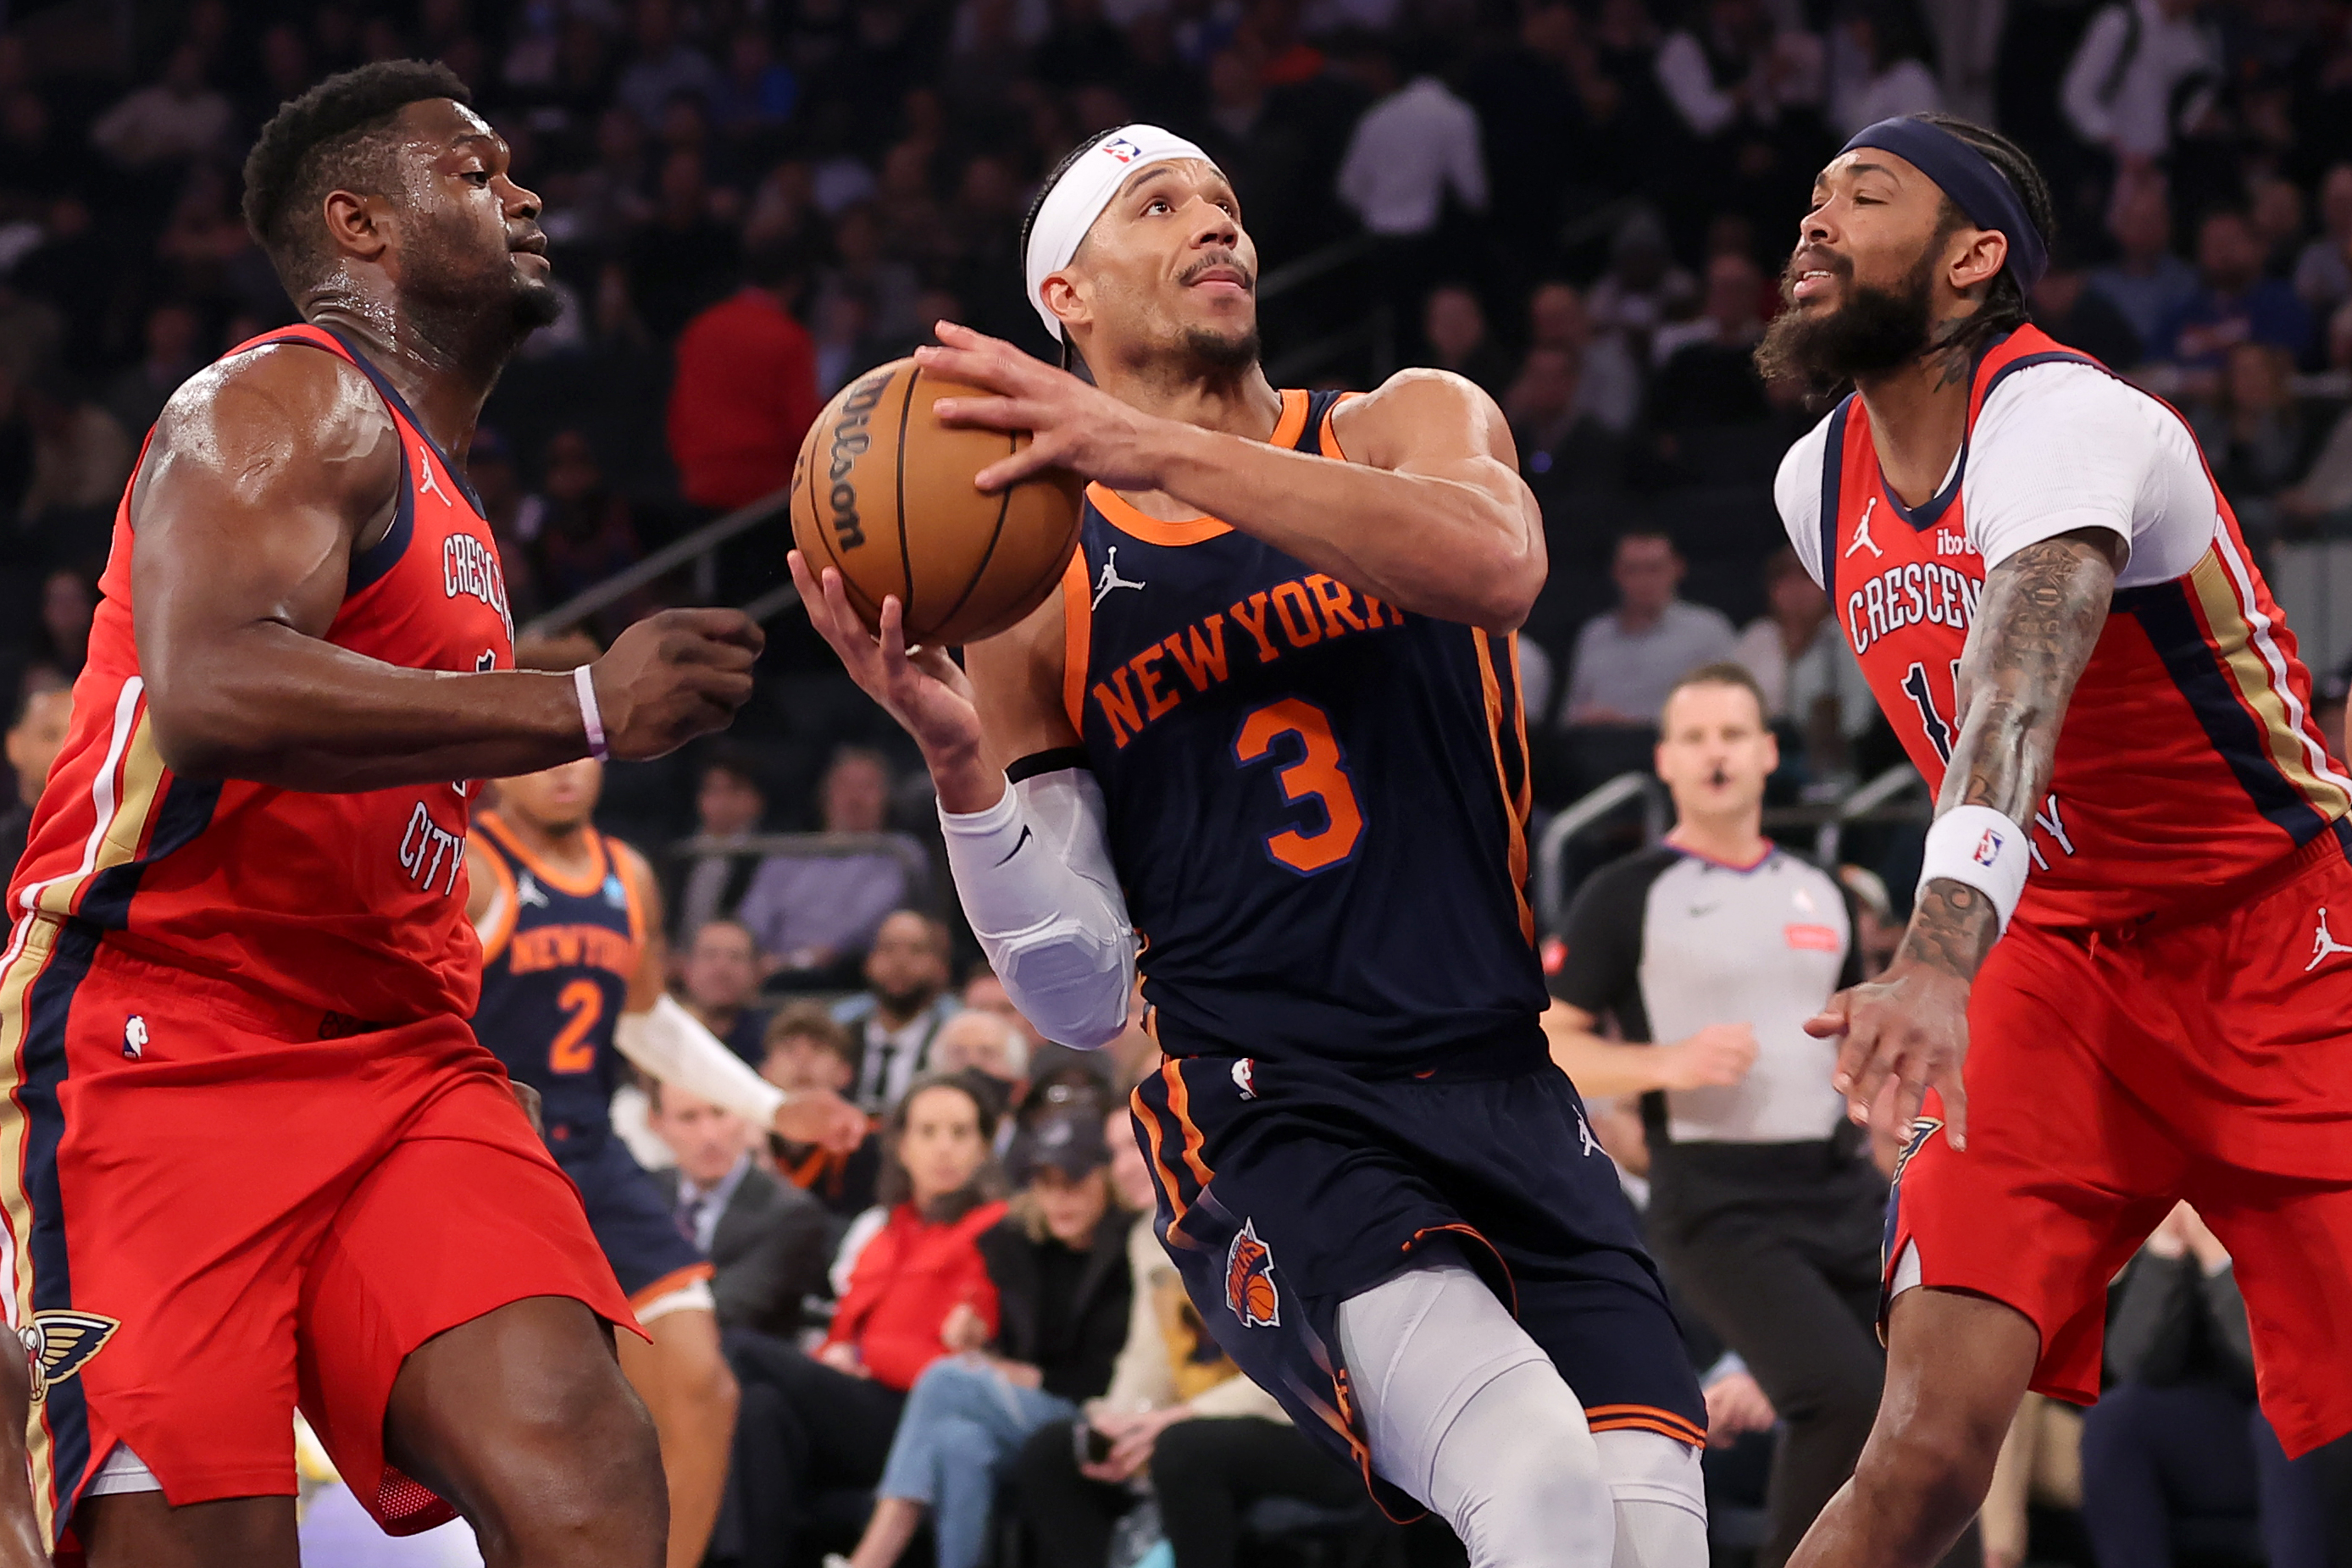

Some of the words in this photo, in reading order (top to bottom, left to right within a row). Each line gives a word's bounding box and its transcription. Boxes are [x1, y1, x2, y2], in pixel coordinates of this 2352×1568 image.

[829, 371, 896, 553] Wilson
[444, 534, 515, 644] CRESC
[1937, 529, 1975, 555] ibot
[1849, 562, 1982, 654] CRESCEN
[1092, 613, 1229, 750] NEW
[1901, 659, 1964, 767] 1
[1230, 696, 1367, 877] 3
[400, 801, 466, 896] CITY
[548, 978, 604, 1074] 2
